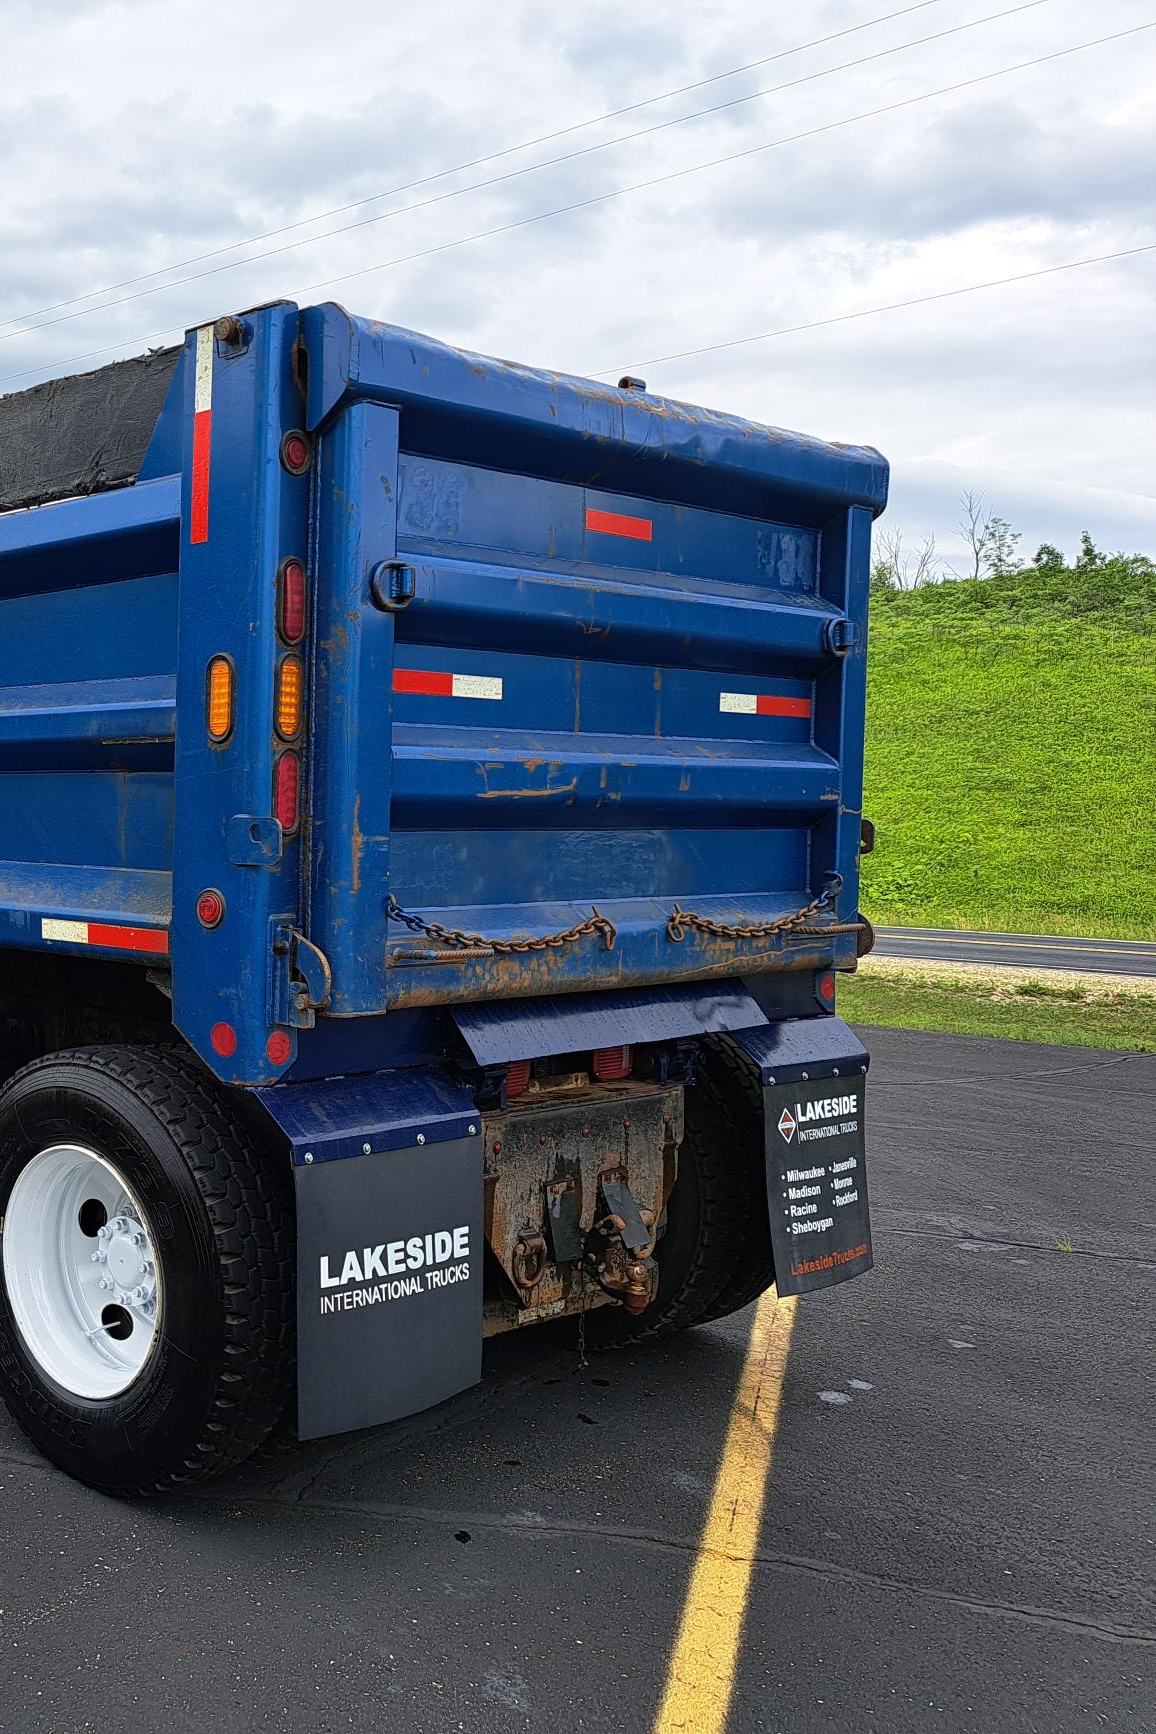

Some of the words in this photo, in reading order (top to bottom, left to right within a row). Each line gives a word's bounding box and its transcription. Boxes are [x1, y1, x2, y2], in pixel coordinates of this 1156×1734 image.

[796, 1094, 858, 1122] LAKESIDE
[799, 1125, 841, 1142] INTERNATIONAL
[840, 1121, 858, 1134] TRUCKS
[832, 1156, 858, 1174] Janesville
[786, 1166, 826, 1183] Milwaukee
[833, 1176, 853, 1190] Monroe
[788, 1184, 822, 1200] Madison
[835, 1188, 858, 1208] Rockford
[790, 1202, 818, 1218] Racine
[791, 1217, 834, 1235] Sheboygan
[319, 1225, 471, 1289] LAKESIDE
[320, 1275, 425, 1315] INTERNATIONAL
[425, 1262, 470, 1292] TRUCKS
